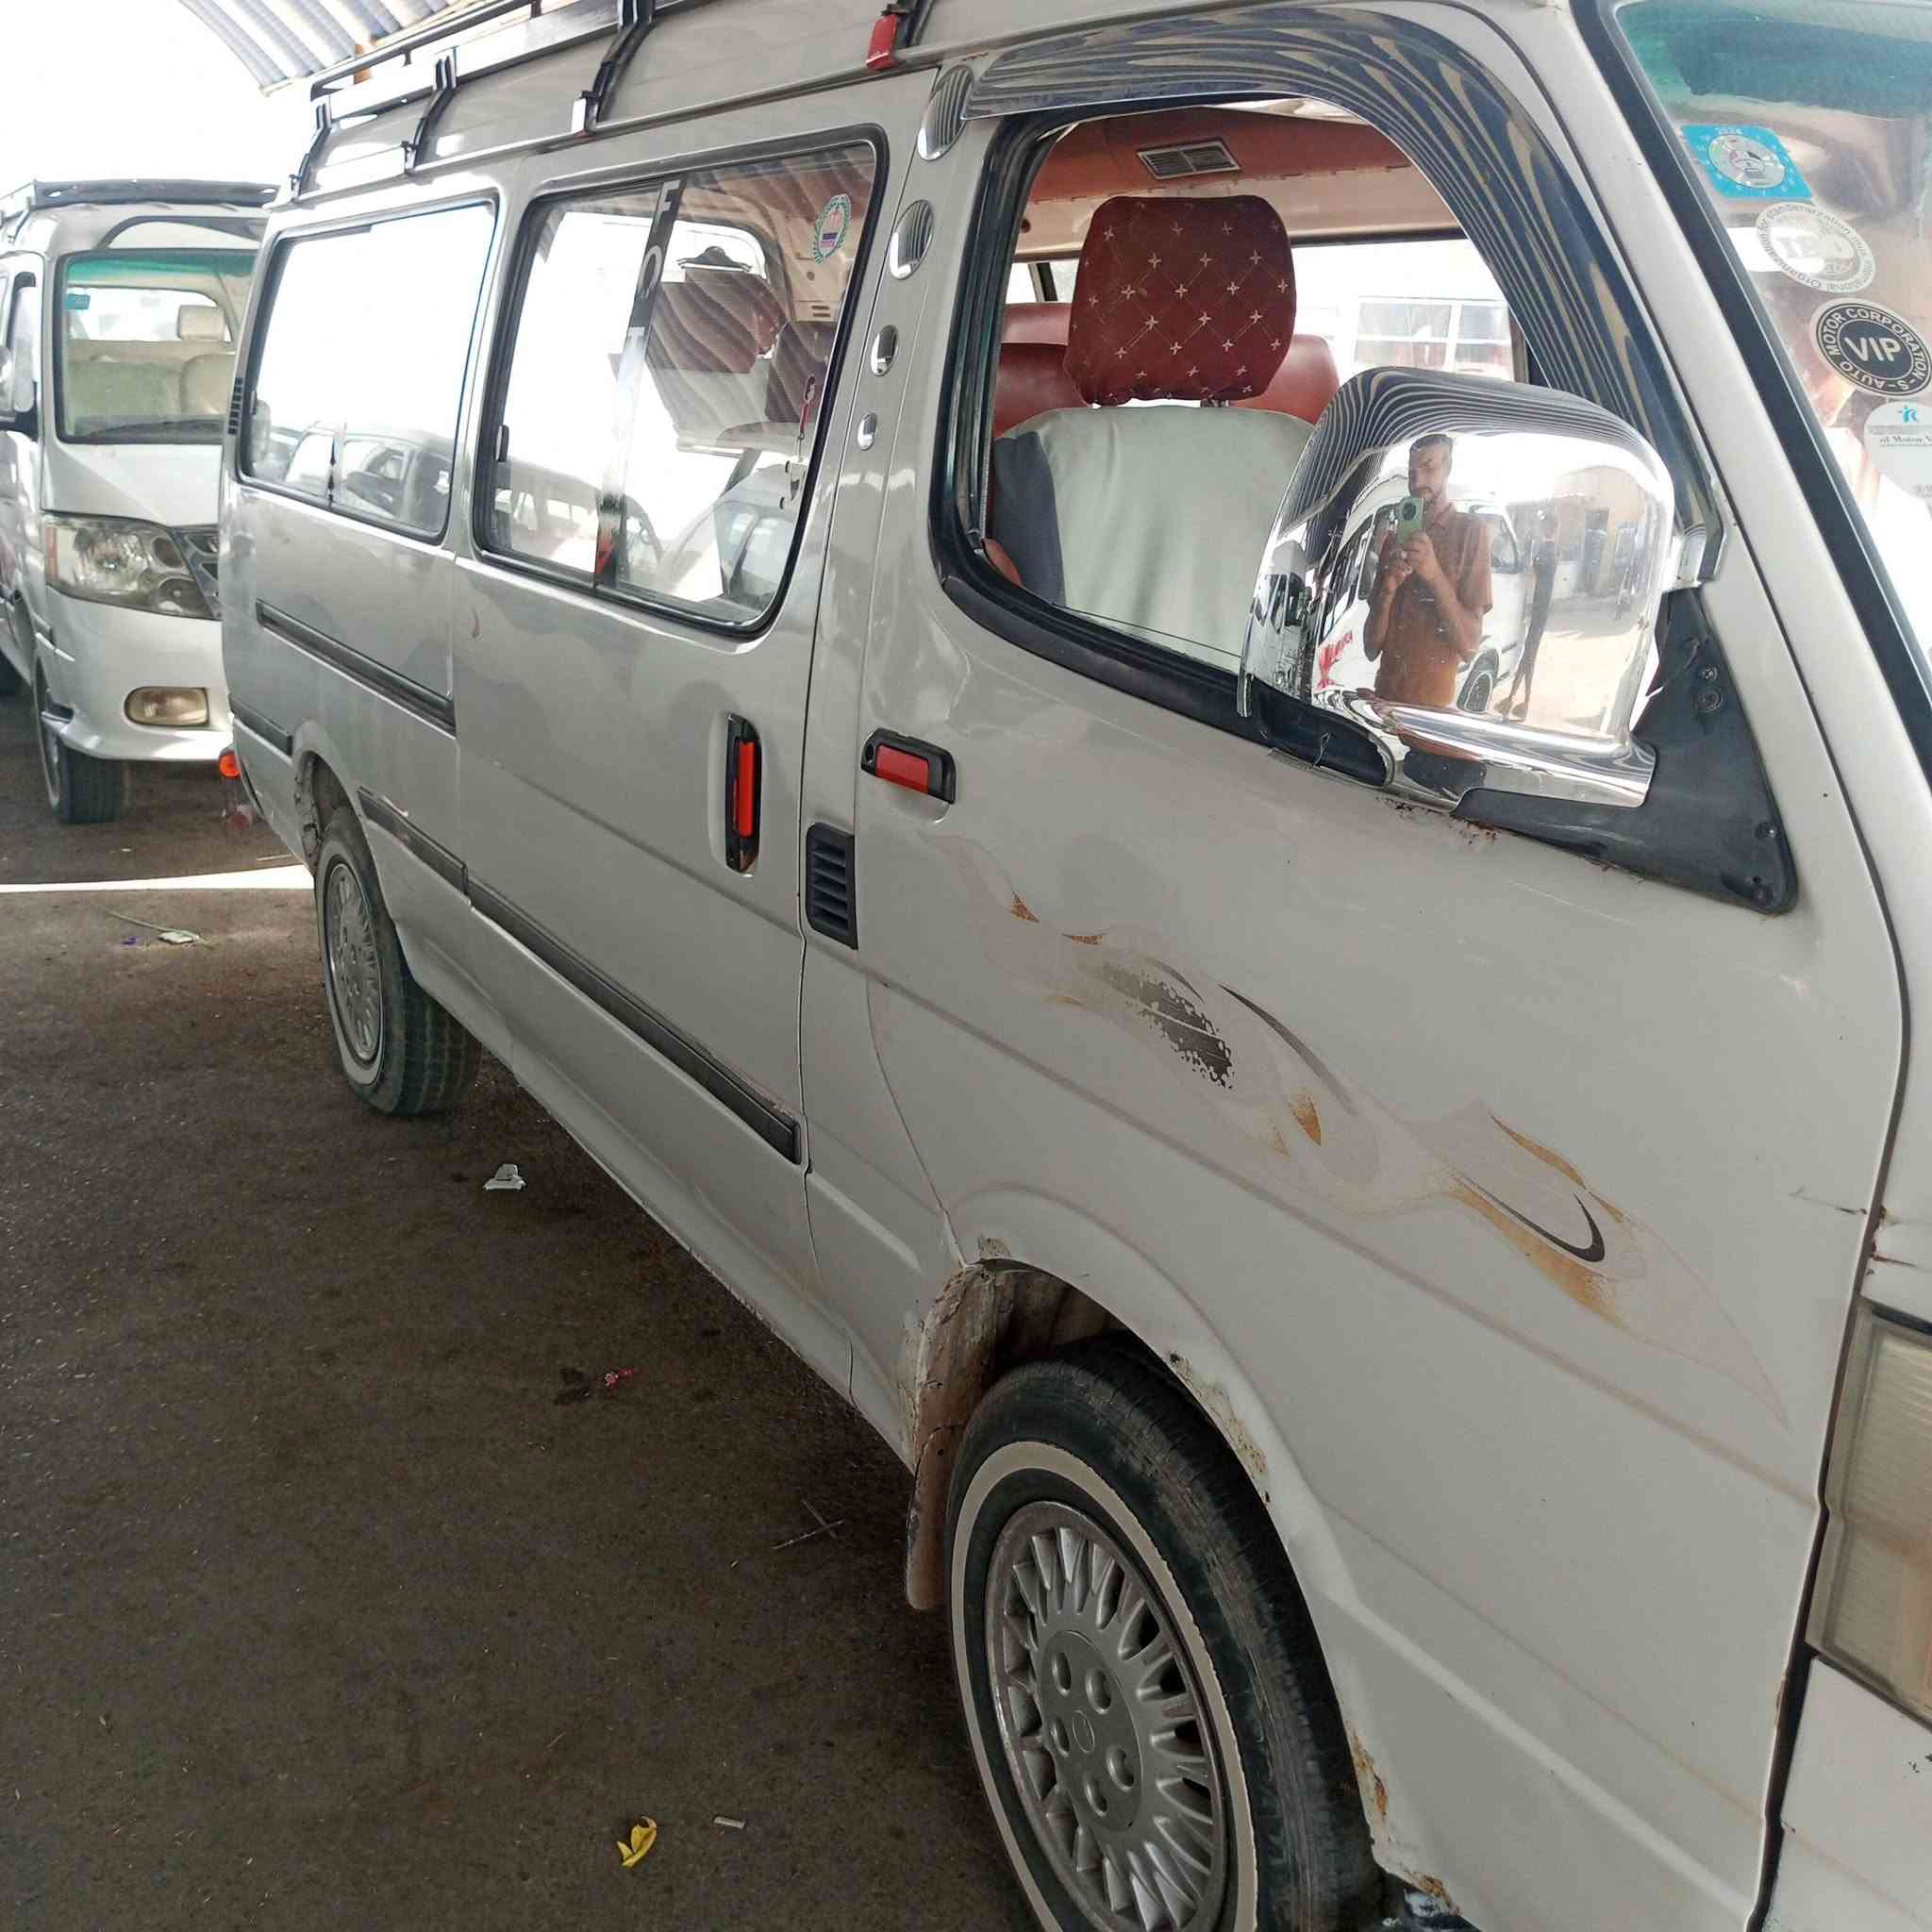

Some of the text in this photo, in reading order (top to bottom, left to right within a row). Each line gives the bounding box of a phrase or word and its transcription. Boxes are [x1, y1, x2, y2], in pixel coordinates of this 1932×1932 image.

[1823, 312, 1846, 356] MOTOR
[1842, 337, 1902, 362] VIP
[1845, 308, 1927, 381] CORPORATION
[1838, 361, 1886, 389] AUTO
